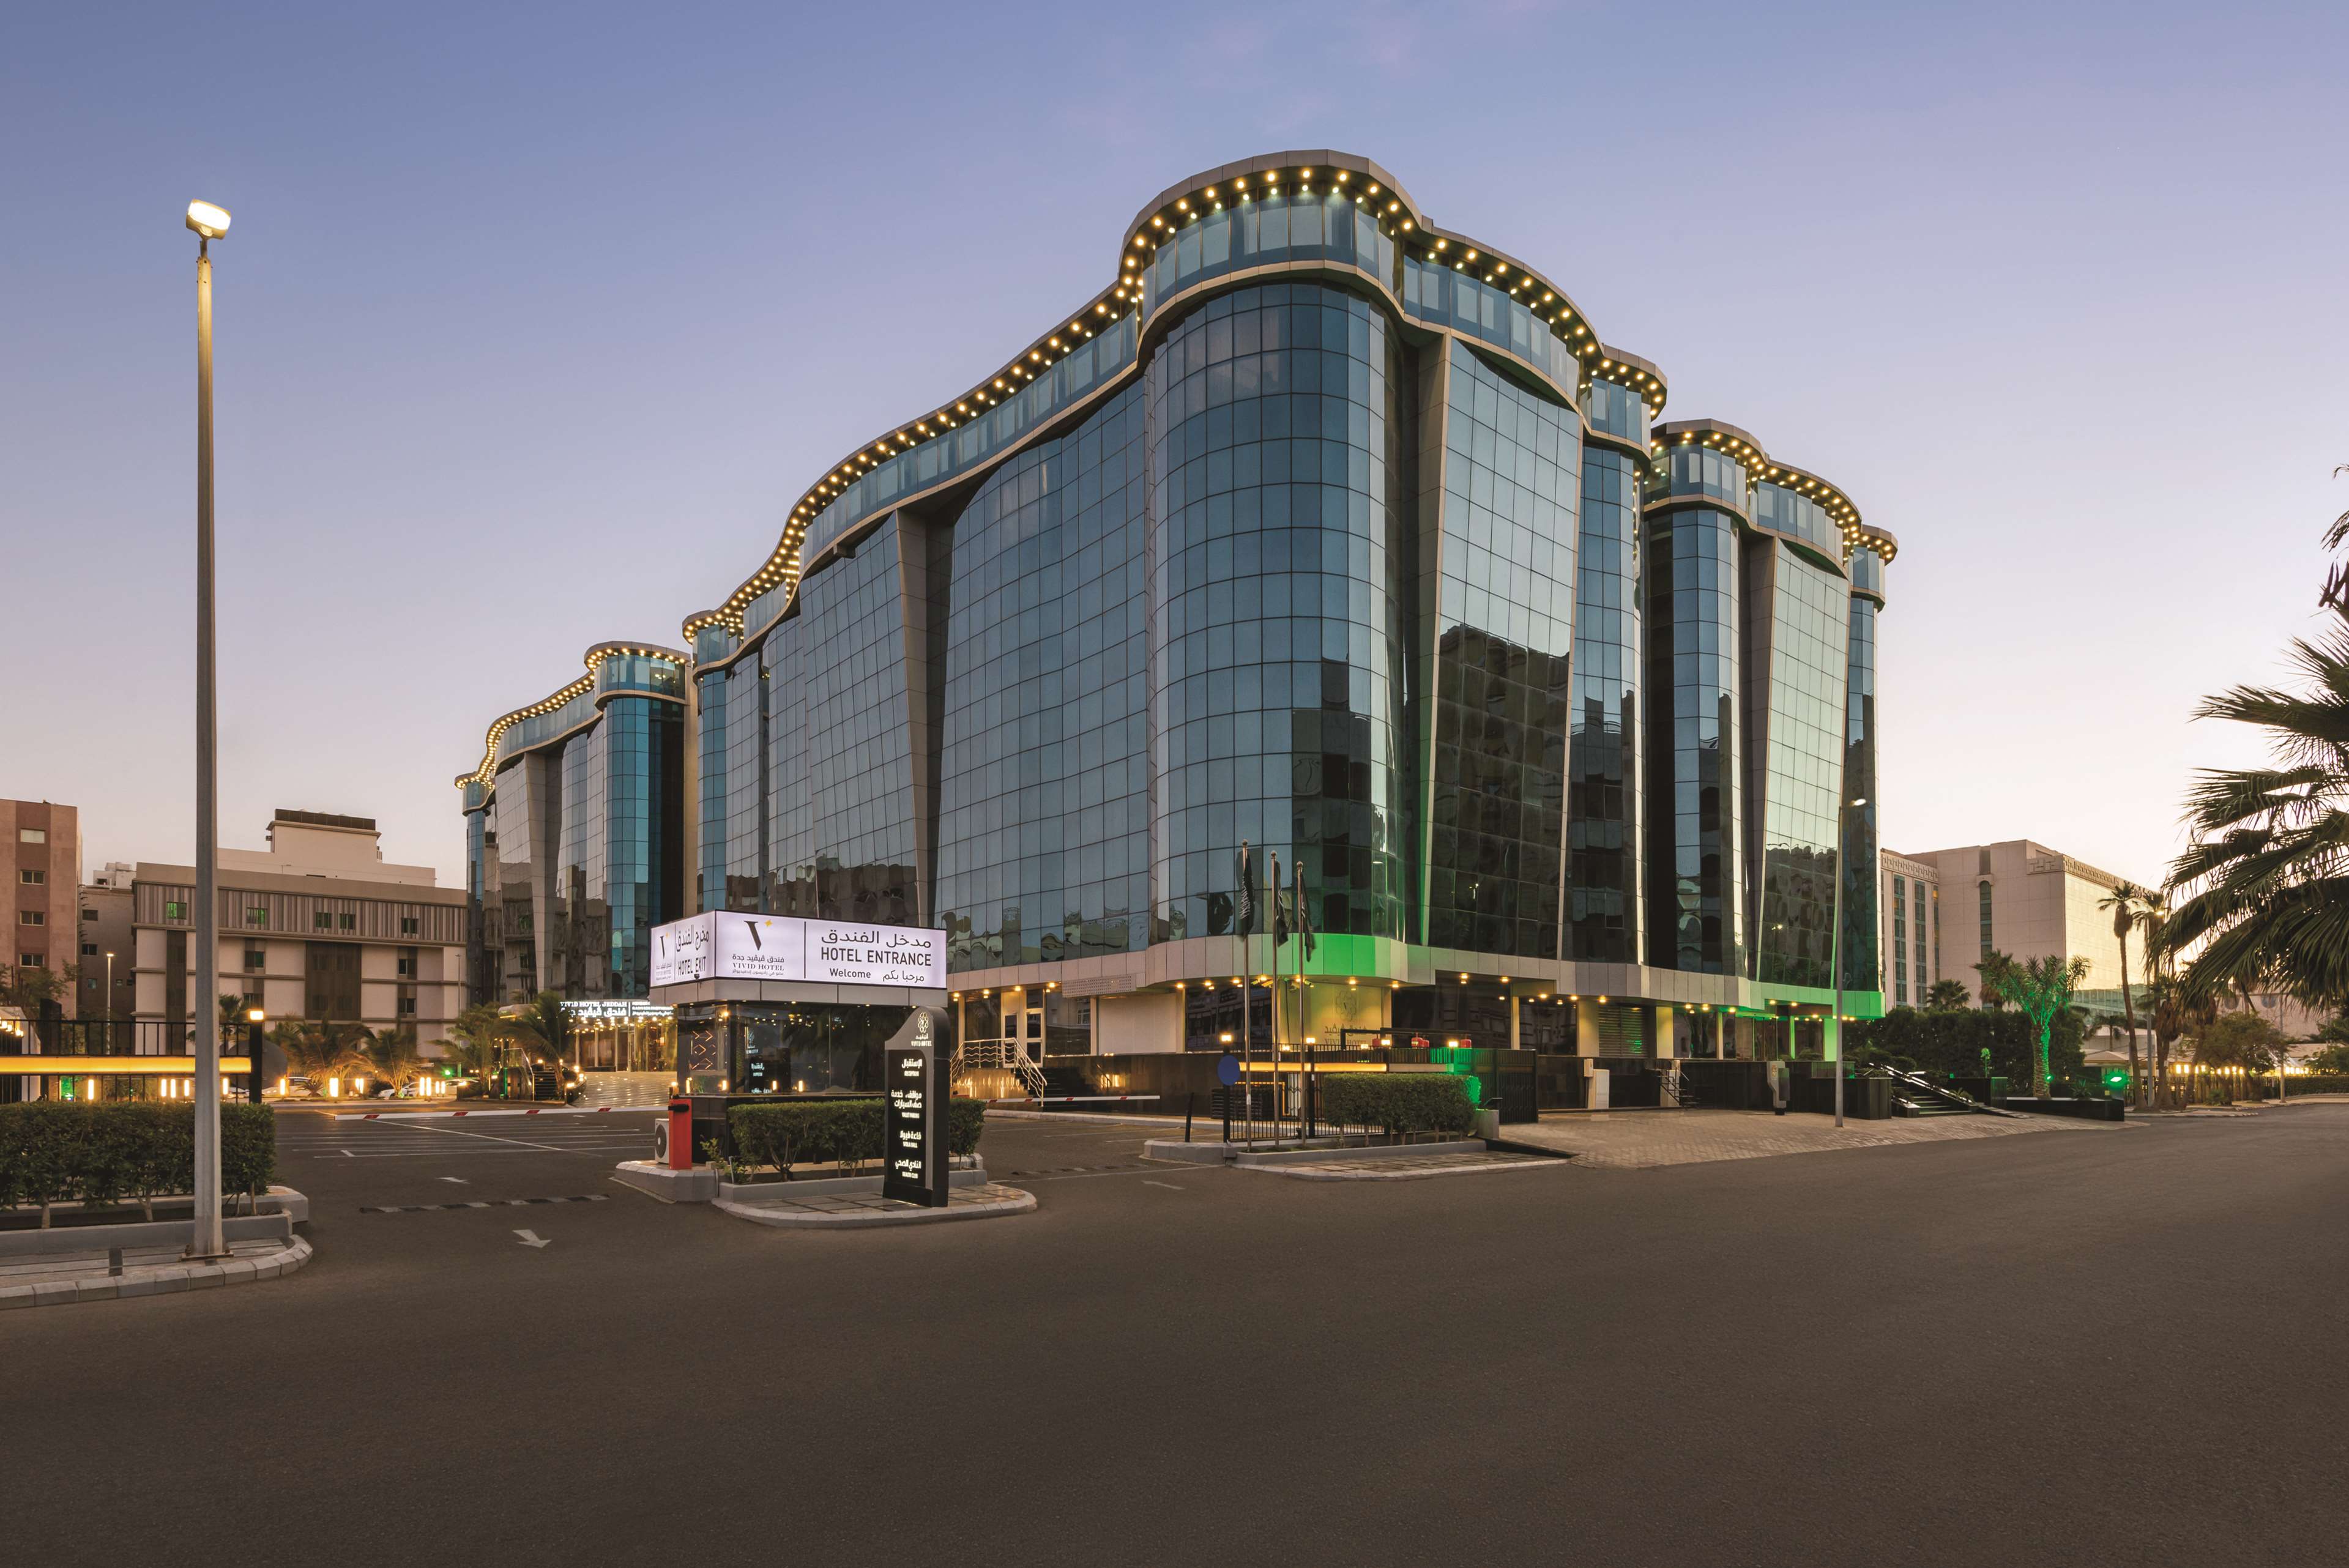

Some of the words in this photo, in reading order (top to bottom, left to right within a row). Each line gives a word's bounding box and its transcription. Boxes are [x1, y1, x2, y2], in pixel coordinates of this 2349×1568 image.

[676, 924, 694, 952] الفندق
[695, 925, 709, 950] مخرج
[821, 929, 879, 944] الفندق
[886, 934, 931, 948] مدخل
[821, 946, 862, 962] HOTEL
[867, 950, 931, 966] ENTRANCE
[678, 959, 693, 976] HOTEL
[695, 956, 706, 973] EXIT
[829, 967, 871, 978] Welcome
[882, 970, 899, 981] بكم
[902, 970, 925, 983] مرحبا
[603, 1008, 627, 1017] فندق
